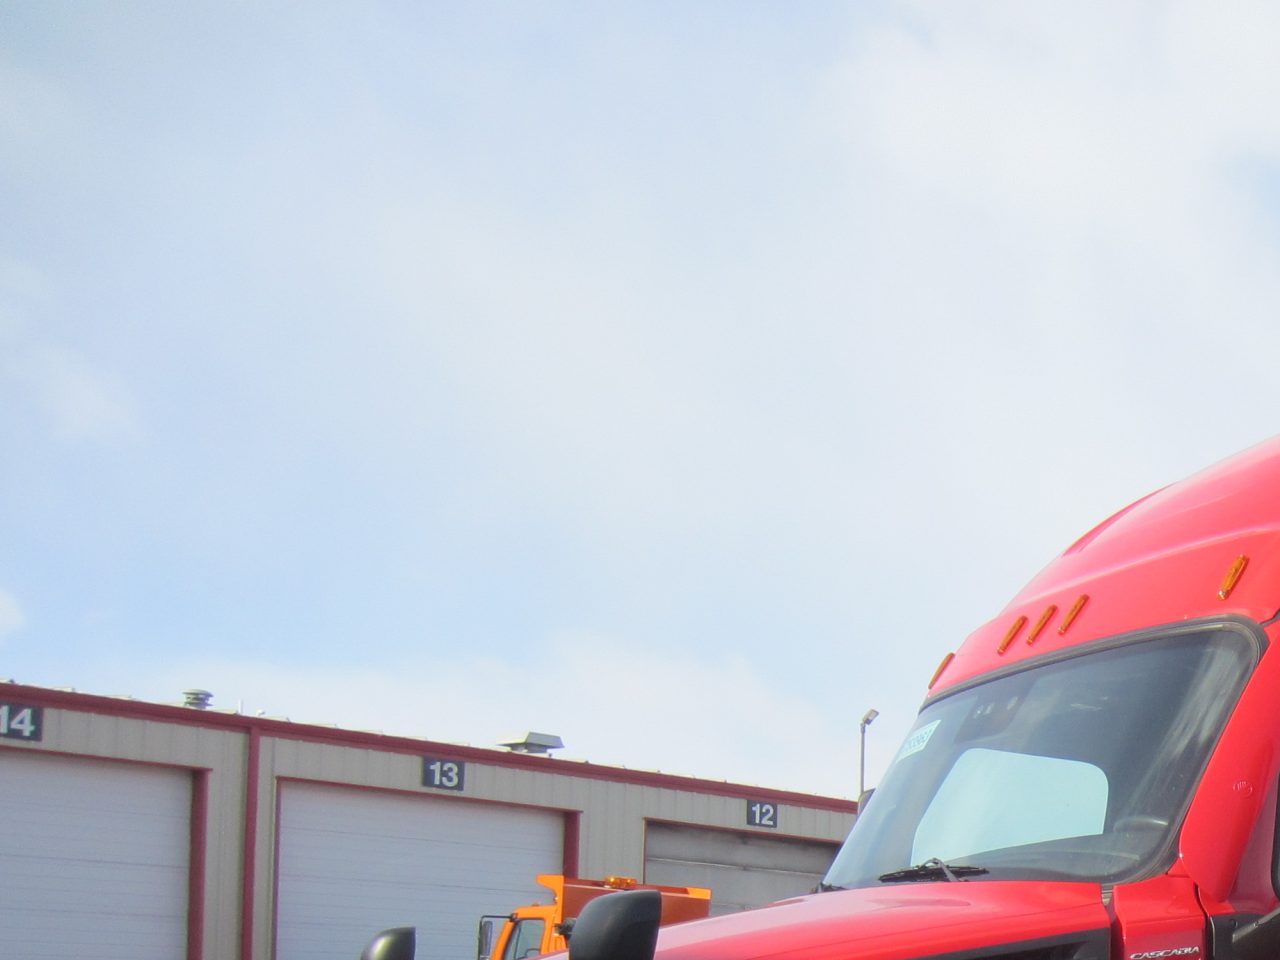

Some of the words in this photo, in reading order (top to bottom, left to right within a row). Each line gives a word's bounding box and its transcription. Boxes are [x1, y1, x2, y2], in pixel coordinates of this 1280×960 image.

[0, 705, 35, 737] 14
[429, 761, 459, 788] 13
[751, 803, 774, 826] 12
[1130, 946, 1200, 960] CASCADIA
